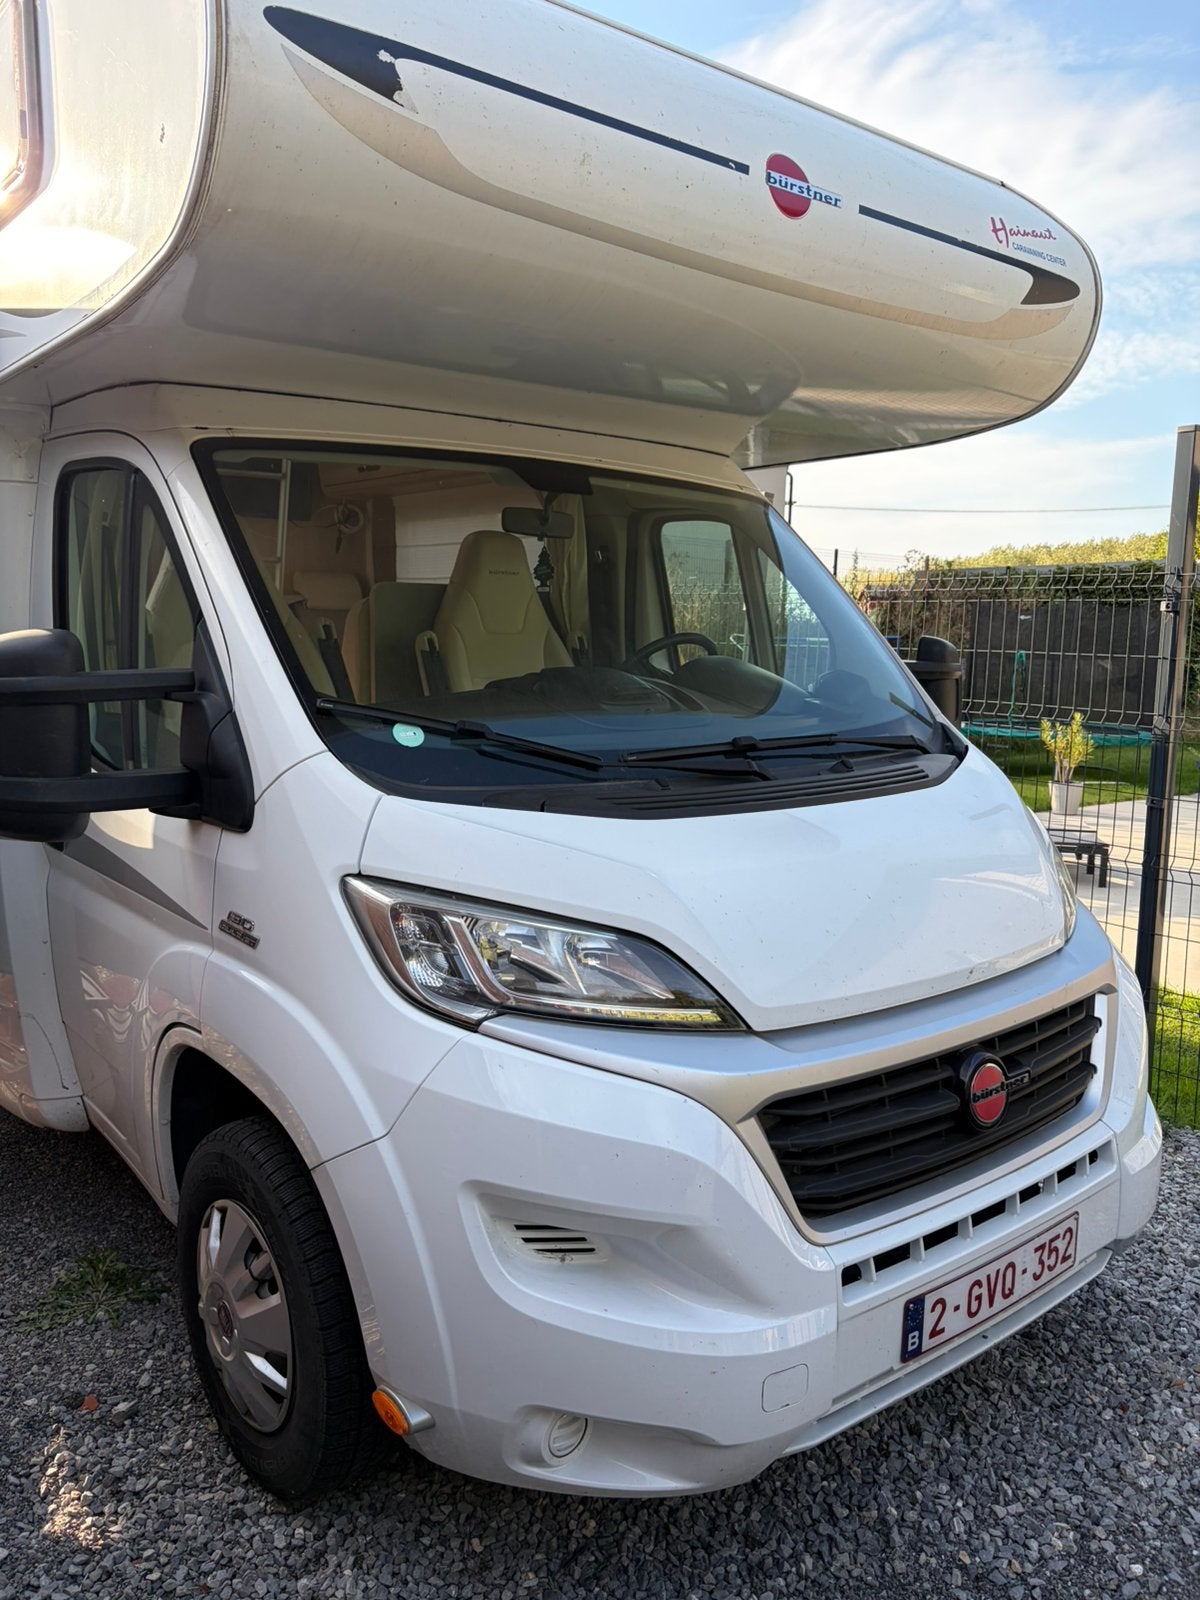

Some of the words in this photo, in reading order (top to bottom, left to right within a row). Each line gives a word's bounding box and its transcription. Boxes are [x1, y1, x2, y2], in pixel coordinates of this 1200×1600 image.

[766, 171, 842, 209] bürstner
[990, 216, 1057, 248] Hainaut
[1012, 242, 1046, 260] CARAVANING
[1046, 254, 1068, 267] CENTER
[972, 1075, 1028, 1104] bürstner
[928, 1227, 1074, 1340] 2-GVQ-352
[907, 1331, 920, 1351] B
